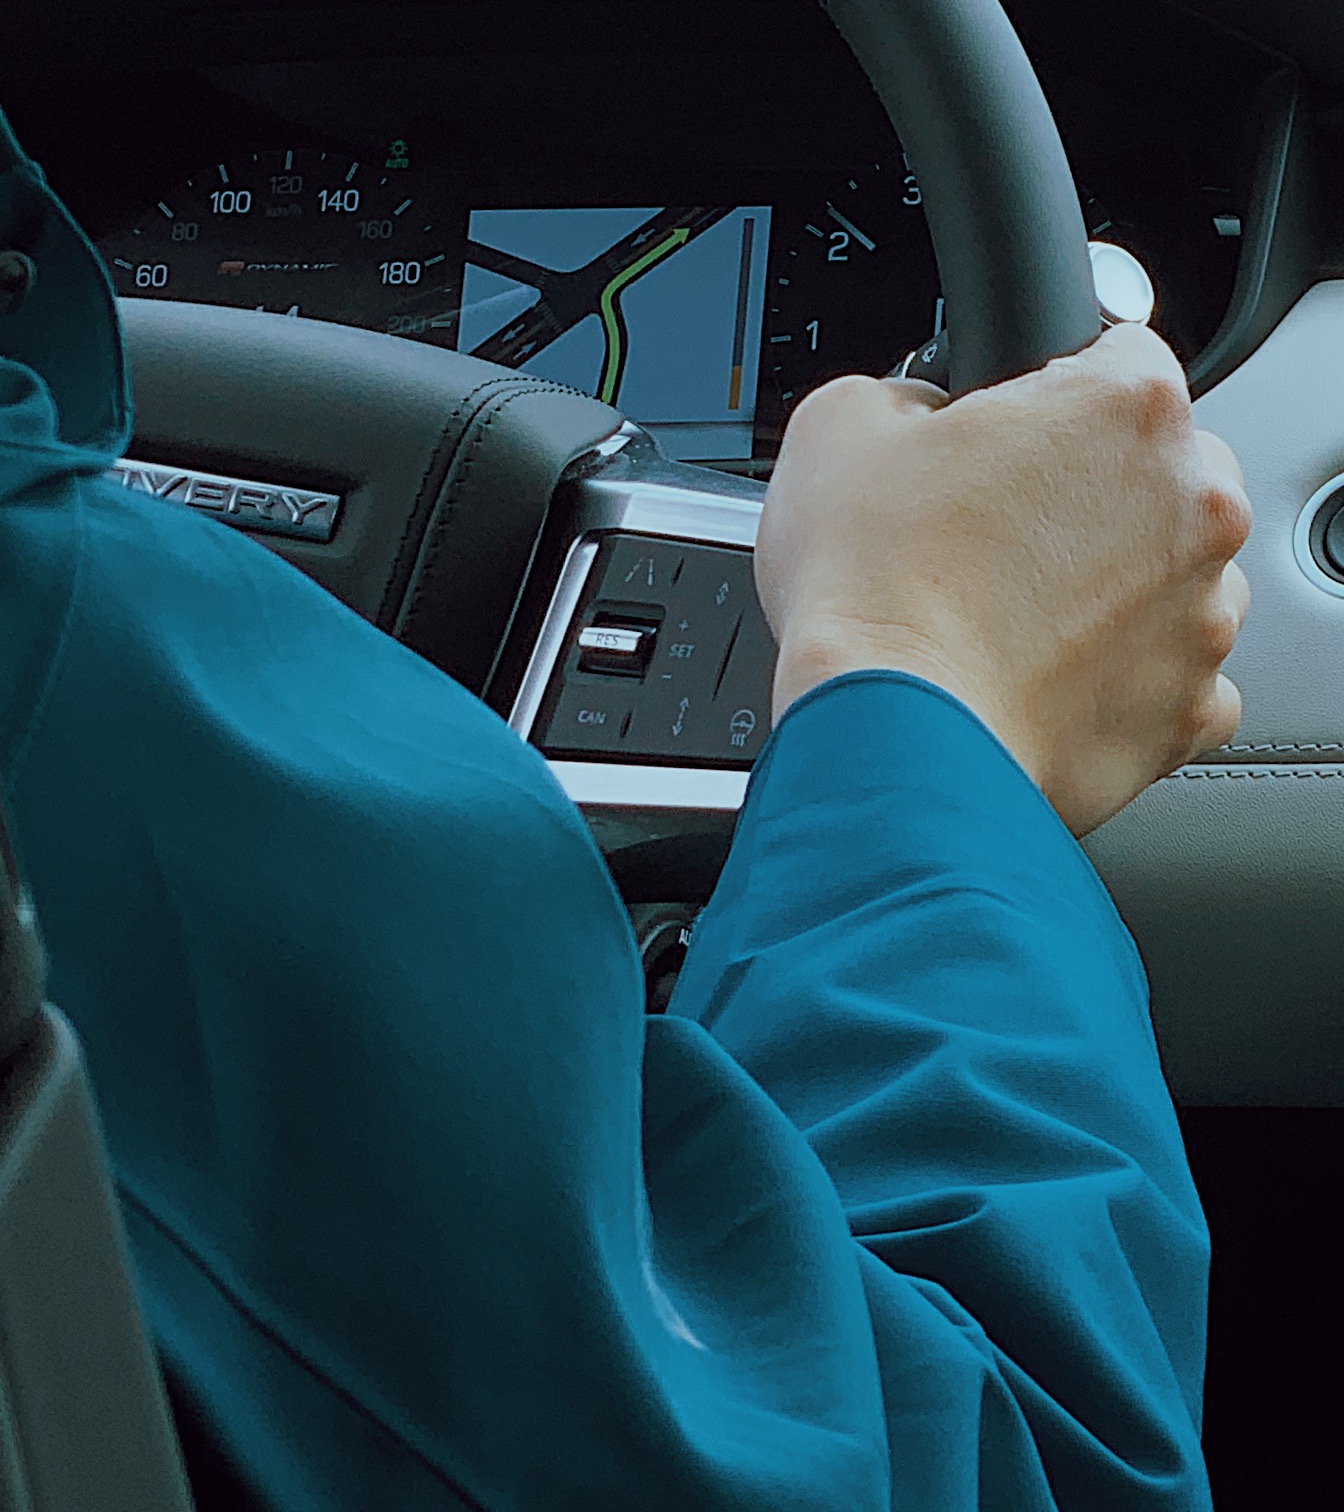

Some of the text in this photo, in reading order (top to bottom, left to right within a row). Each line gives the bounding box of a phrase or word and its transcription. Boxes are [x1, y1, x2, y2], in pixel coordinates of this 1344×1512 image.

[210, 190, 251, 214] 100
[318, 189, 360, 213] 140
[902, 175, 923, 206] 3
[171, 222, 198, 241] 80
[359, 219, 393, 240] 160
[827, 231, 849, 261] 2
[135, 264, 168, 288] 60
[379, 261, 421, 285] 180
[805, 320, 819, 351] 1
[595, 634, 620, 647] RES
[669, 643, 696, 659] SET
[577, 709, 607, 725] CAN
